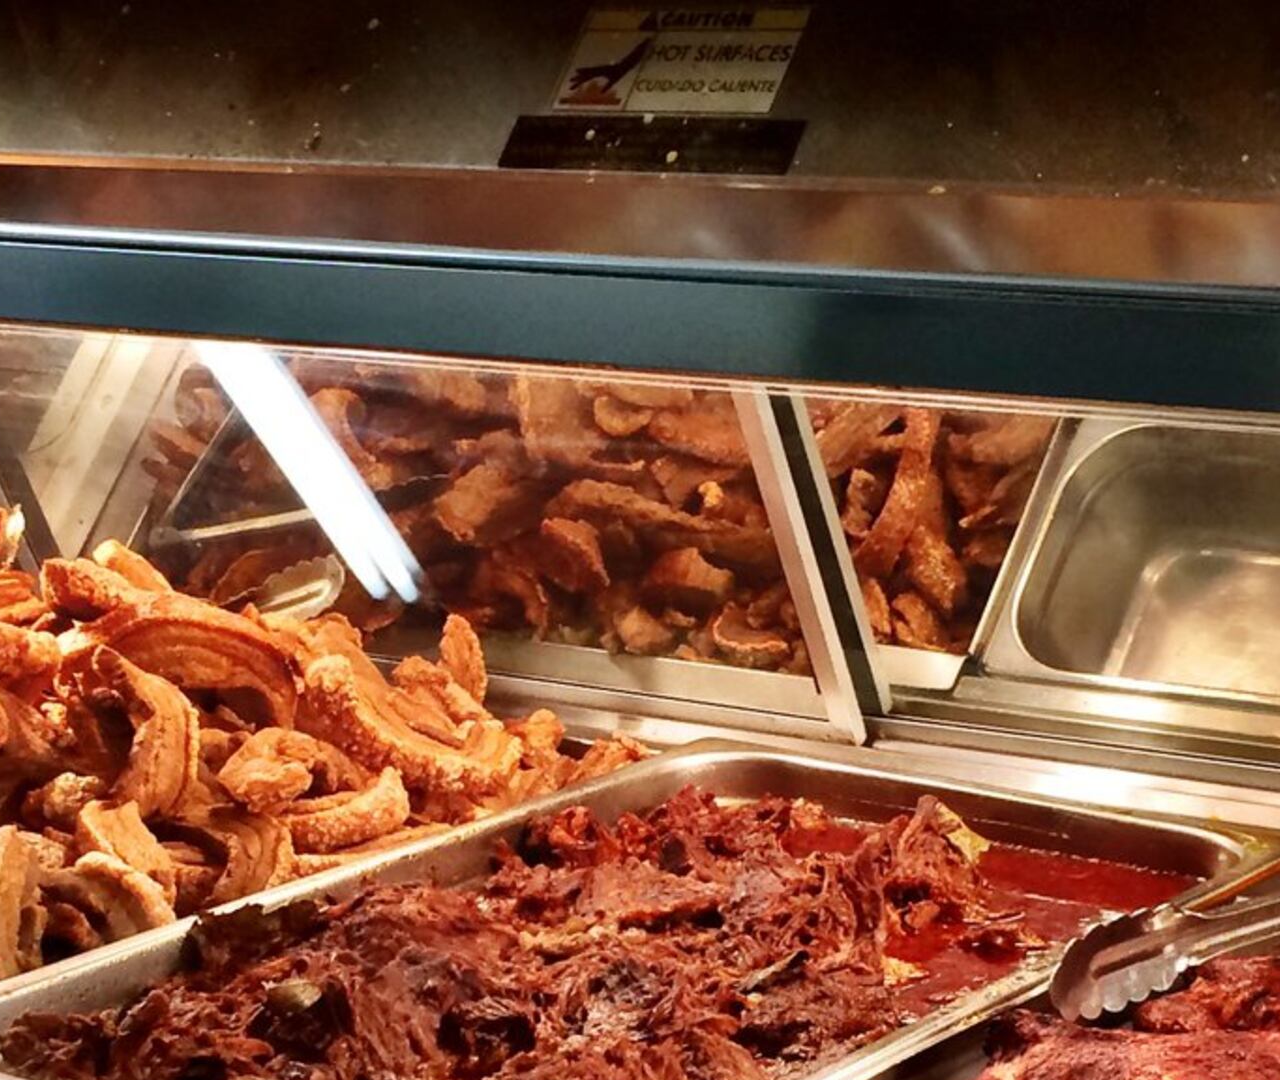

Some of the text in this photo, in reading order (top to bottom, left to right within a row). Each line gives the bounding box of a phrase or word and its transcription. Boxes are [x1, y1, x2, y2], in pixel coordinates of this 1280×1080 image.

[661, 11, 756, 28] CAUTION
[647, 44, 794, 62] HOT SURFACES
[635, 79, 777, 93] CUIDADO CALIENTE
